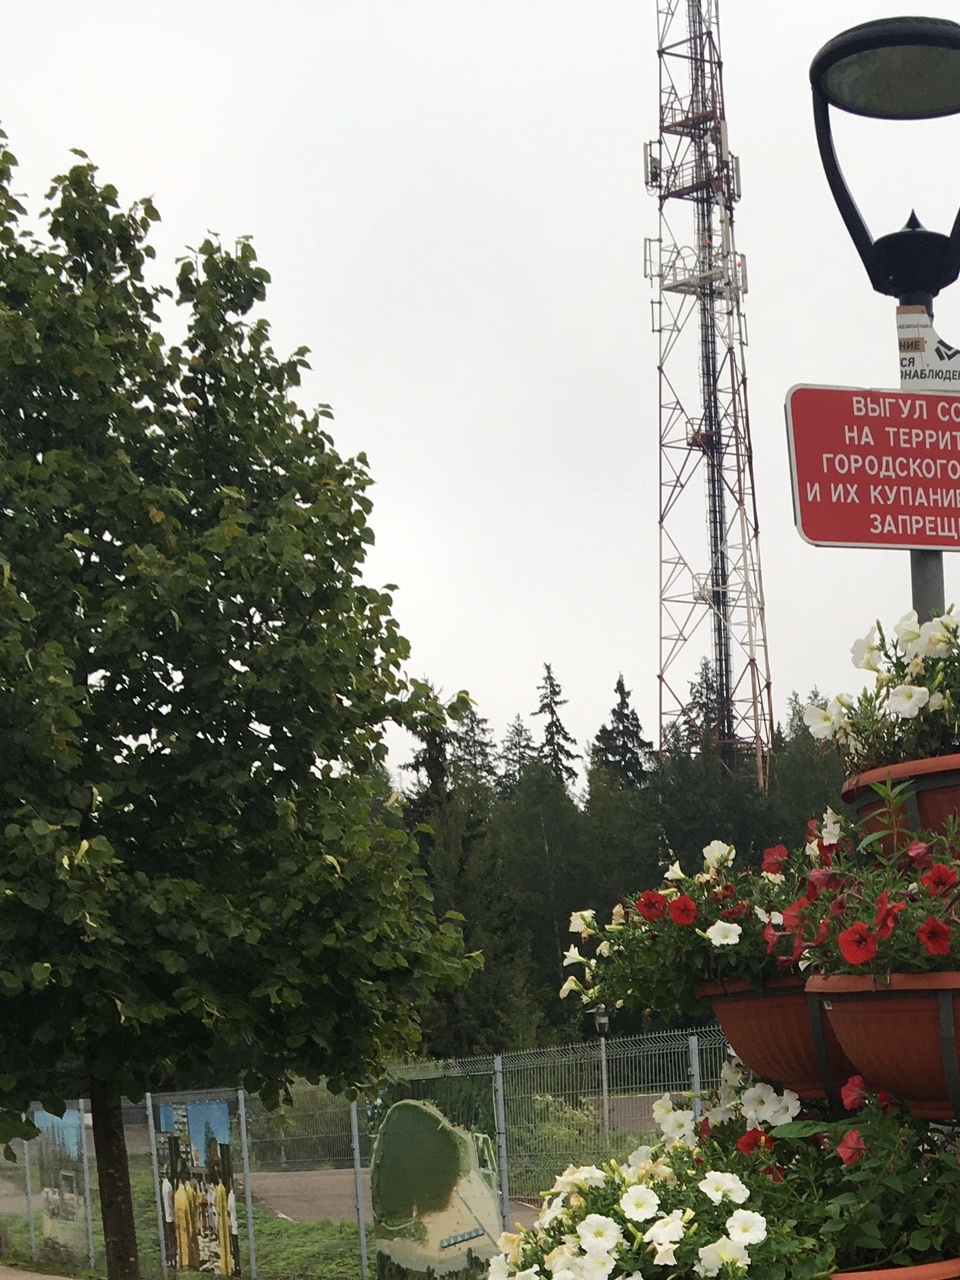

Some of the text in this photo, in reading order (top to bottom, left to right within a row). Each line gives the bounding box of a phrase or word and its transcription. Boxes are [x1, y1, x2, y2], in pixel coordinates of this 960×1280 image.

[852, 396, 927, 420] ВЫГУЛ
[844, 425, 874, 446] НА
[822, 453, 960, 480] ГОРОДСКОГО
[806, 482, 821, 502] И
[830, 483, 860, 504] ИХ
